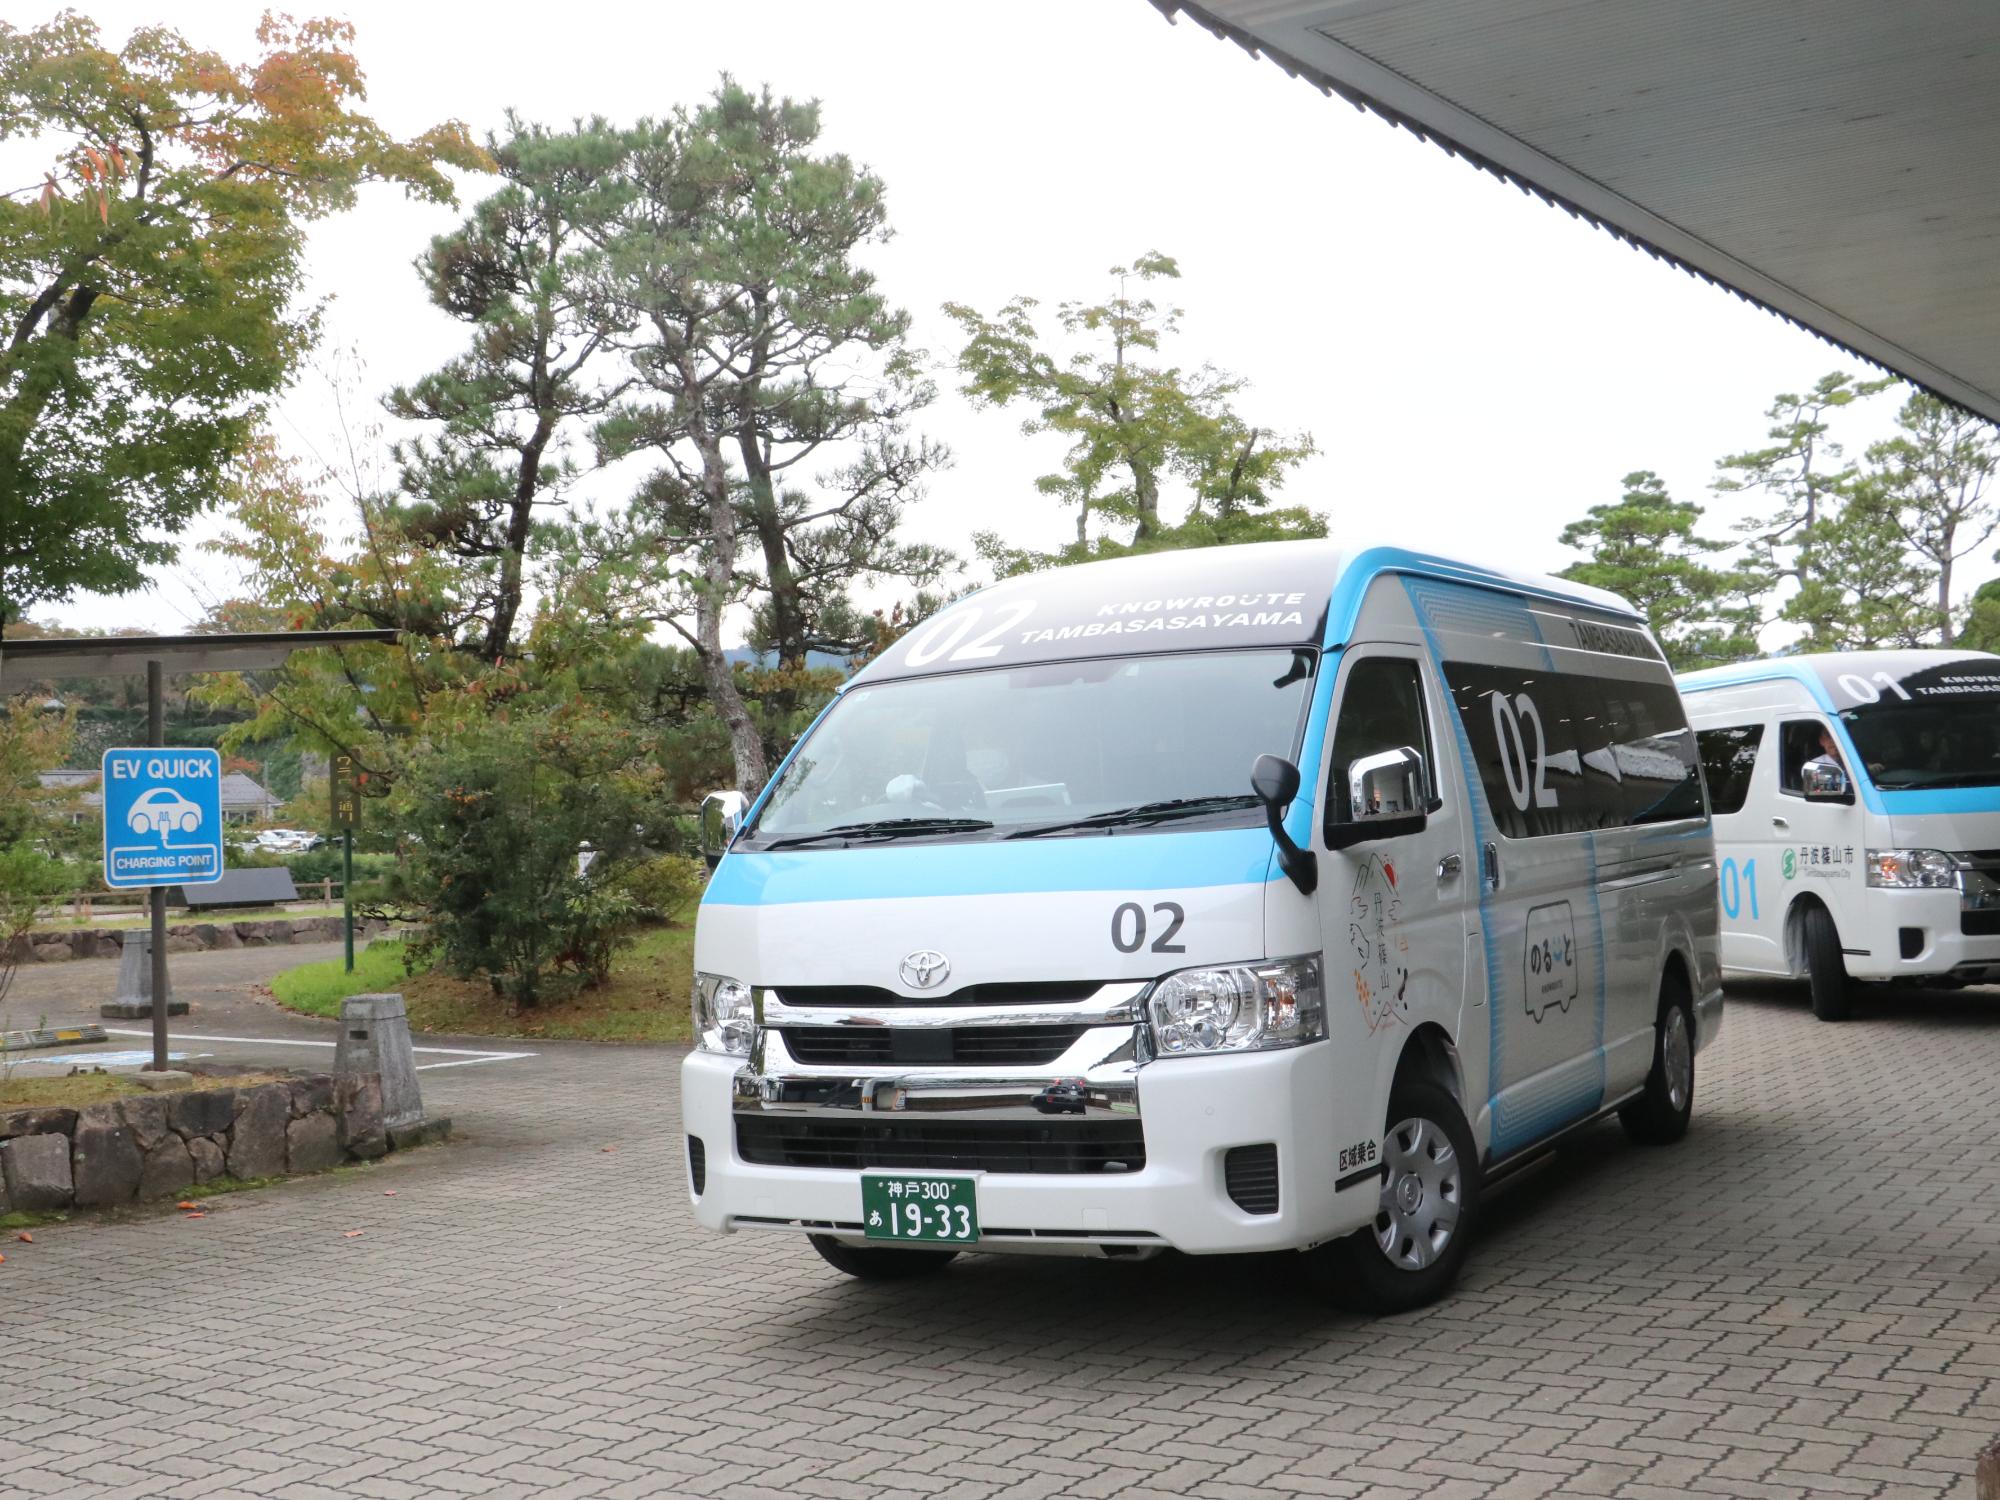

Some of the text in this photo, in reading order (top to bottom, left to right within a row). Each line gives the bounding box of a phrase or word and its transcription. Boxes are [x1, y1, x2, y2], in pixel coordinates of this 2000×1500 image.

[904, 598, 1037, 668] 02
[1020, 611, 1303, 644] TAMBASASAYAMA
[1837, 671, 1912, 704] 01
[1940, 675, 2000, 684] KNOWR
[1491, 690, 1560, 812] 02
[112, 758, 213, 780] EV QUICK
[116, 854, 212, 869] CHARGING POINT
[1720, 857, 1759, 920] 01
[1111, 901, 1186, 954] 02
[1339, 1139, 1377, 1172] 区域乗合
[869, 1202, 971, 1239] あ 19-33
